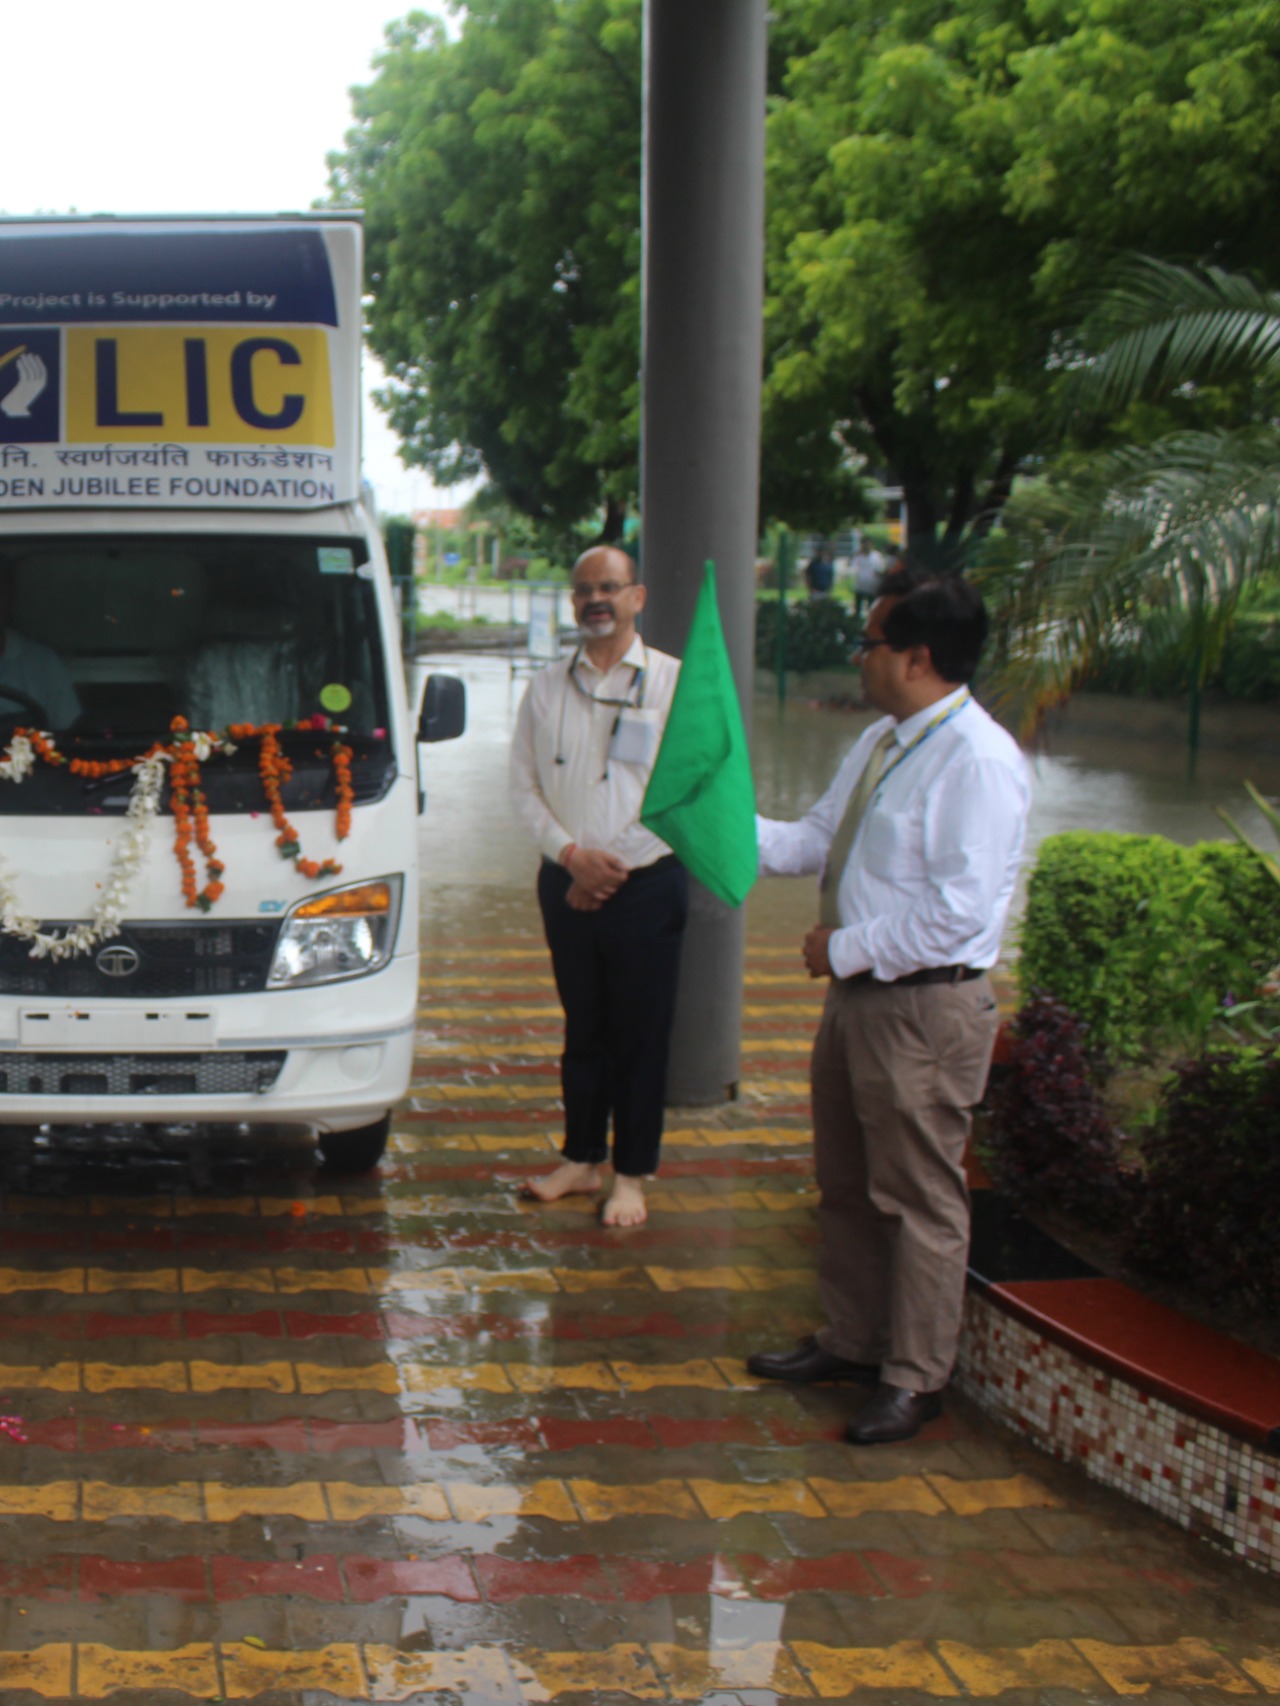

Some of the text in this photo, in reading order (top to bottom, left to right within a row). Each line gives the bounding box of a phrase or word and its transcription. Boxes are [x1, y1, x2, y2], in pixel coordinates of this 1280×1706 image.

[87, 291, 107, 306] is
[112, 291, 241, 309] Supported
[247, 290, 277, 308] by
[95, 337, 305, 430] LIC
[52, 476, 161, 496] JUBILEE
[170, 477, 335, 500] FOUNDATION
